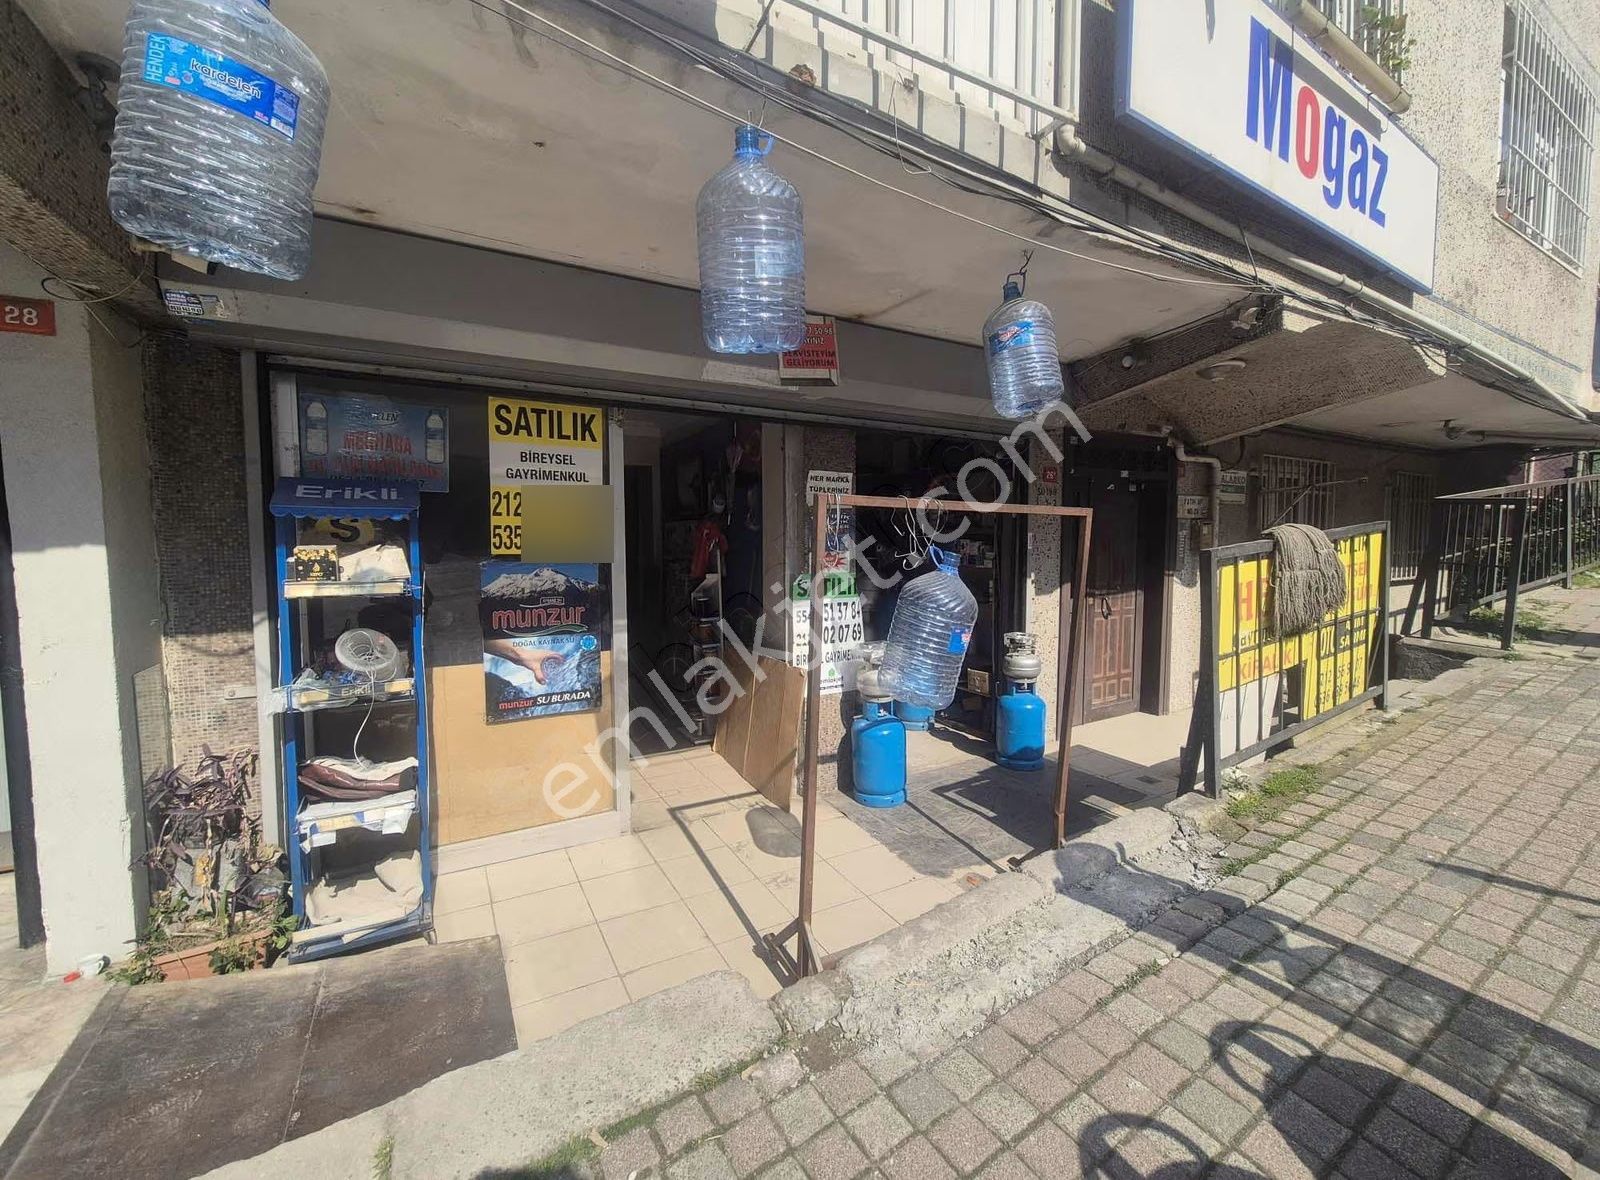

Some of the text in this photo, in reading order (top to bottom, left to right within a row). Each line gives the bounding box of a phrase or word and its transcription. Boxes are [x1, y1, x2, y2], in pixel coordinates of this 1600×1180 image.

[146, 34, 166, 82] HENDEK
[190, 57, 262, 99] kardelen
[1246, 16, 1389, 228] Mogaz
[5, 305, 38, 326] 28
[494, 404, 597, 442] SATILIK
[520, 450, 576, 466] BİREYSEL
[506, 467, 590, 483] GAYRİMENKUL
[295, 485, 400, 500] Erikli
[492, 606, 586, 629] munzur
[838, 624, 850, 643] 07
[499, 690, 591, 710] munzur SU BURADA
